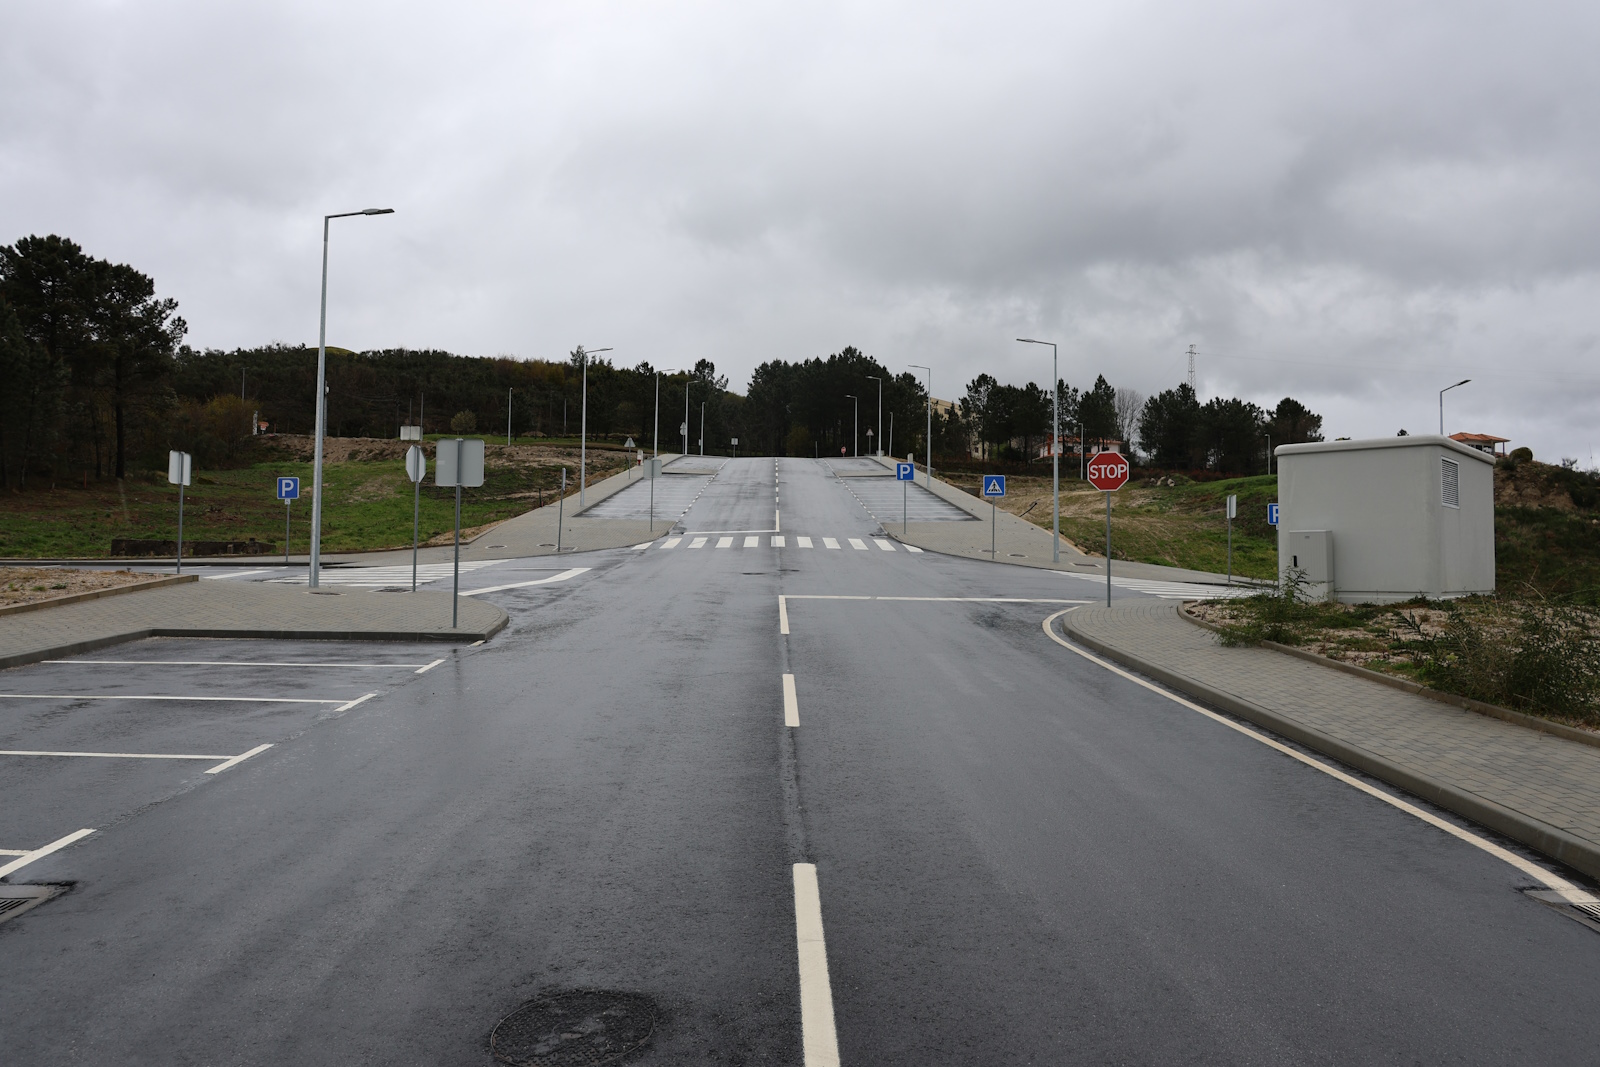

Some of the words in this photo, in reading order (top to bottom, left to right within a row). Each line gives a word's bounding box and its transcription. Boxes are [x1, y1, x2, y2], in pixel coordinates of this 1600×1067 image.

[900, 465, 911, 479] P
[1089, 464, 1127, 479] STOP
[282, 480, 294, 497] P
